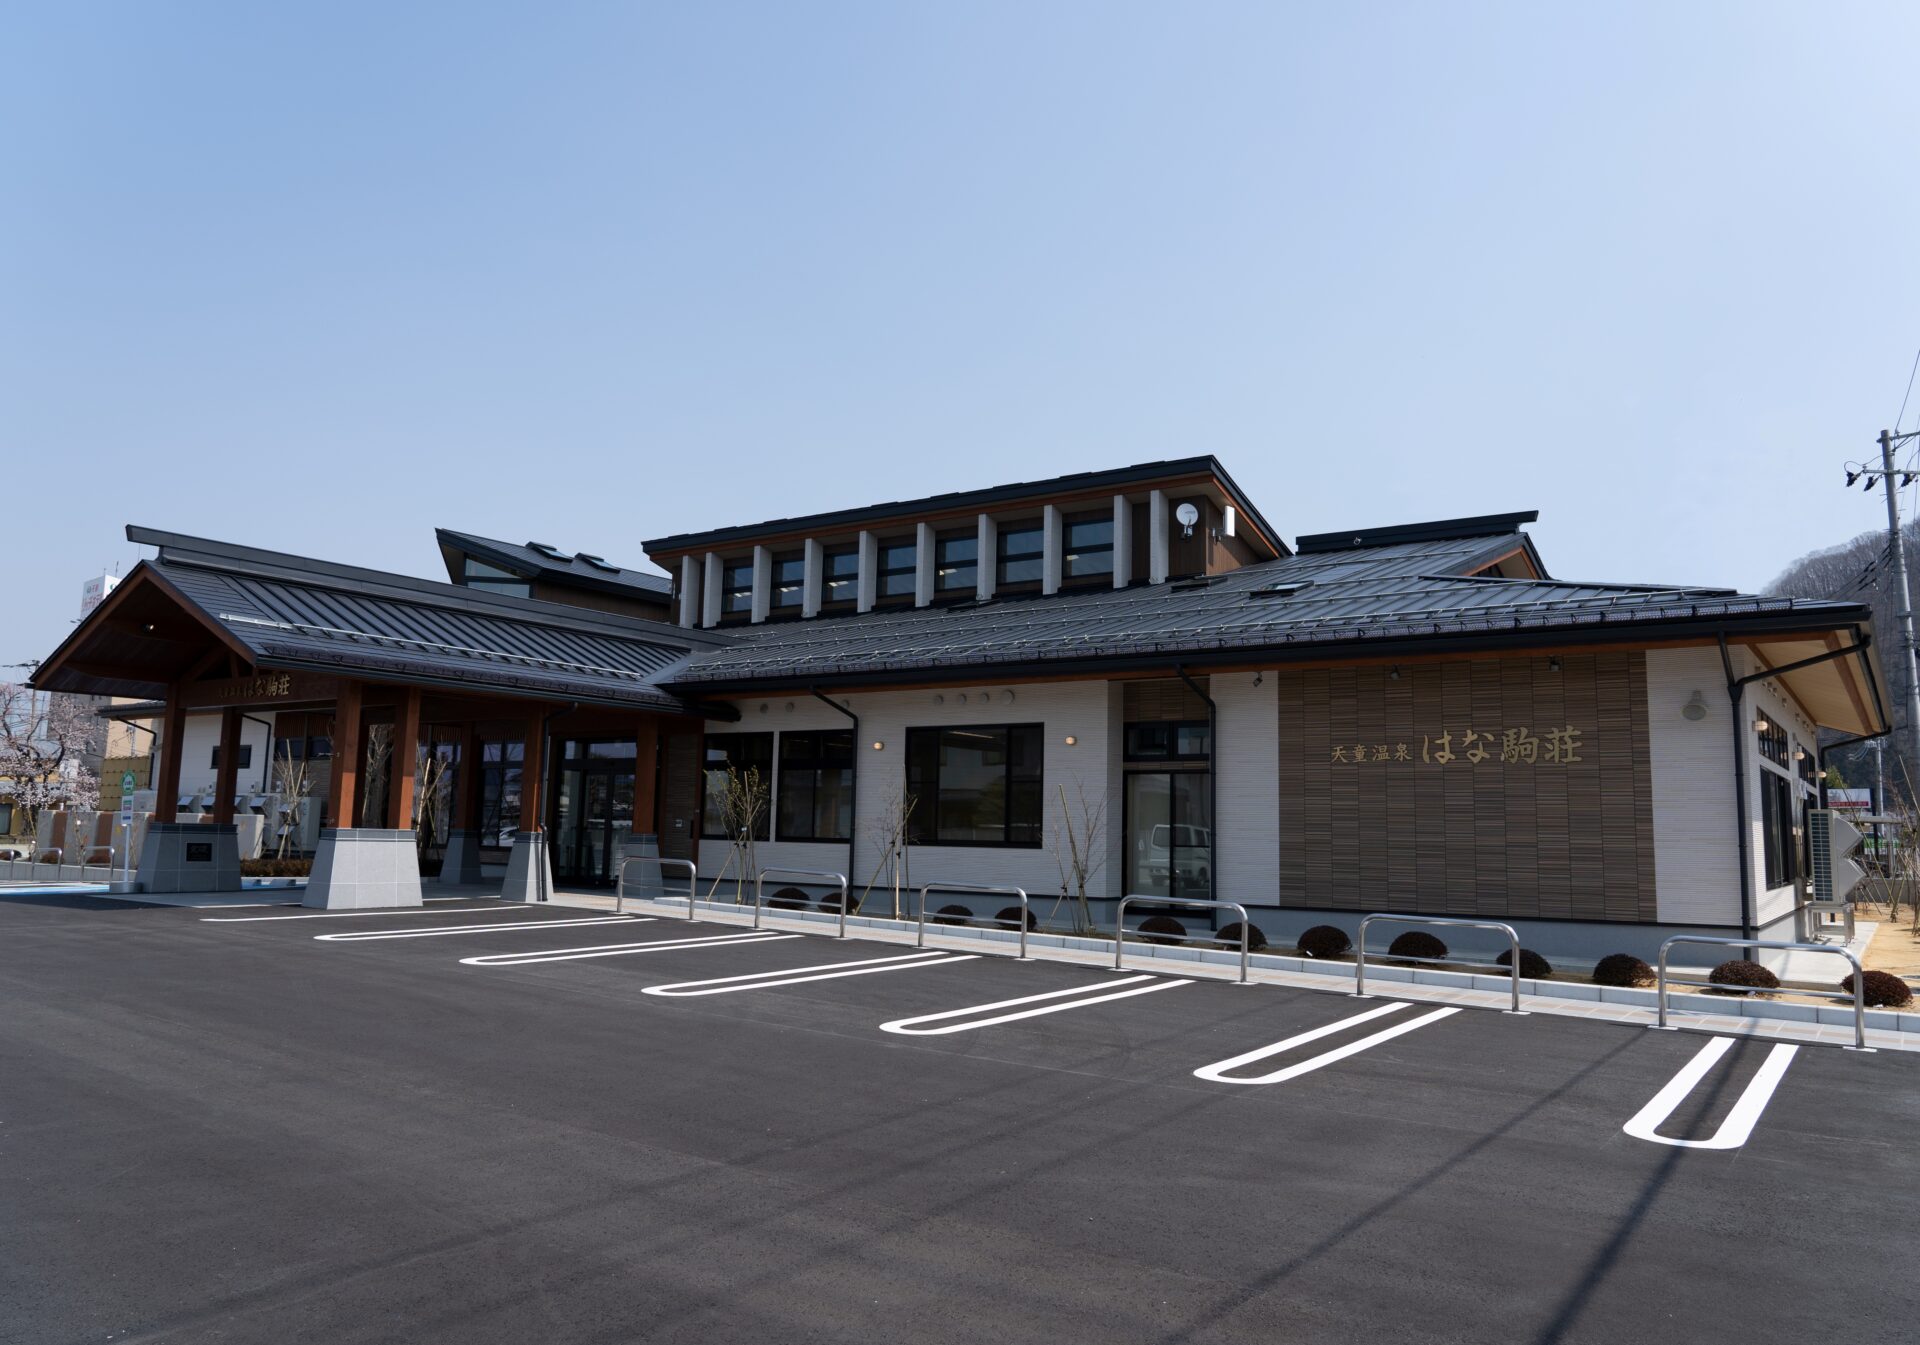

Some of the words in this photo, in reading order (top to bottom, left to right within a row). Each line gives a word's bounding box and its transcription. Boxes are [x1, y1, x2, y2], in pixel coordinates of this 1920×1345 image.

[1331, 743, 1412, 763] 天童温泉
[1422, 725, 1583, 764] はな駒荘
